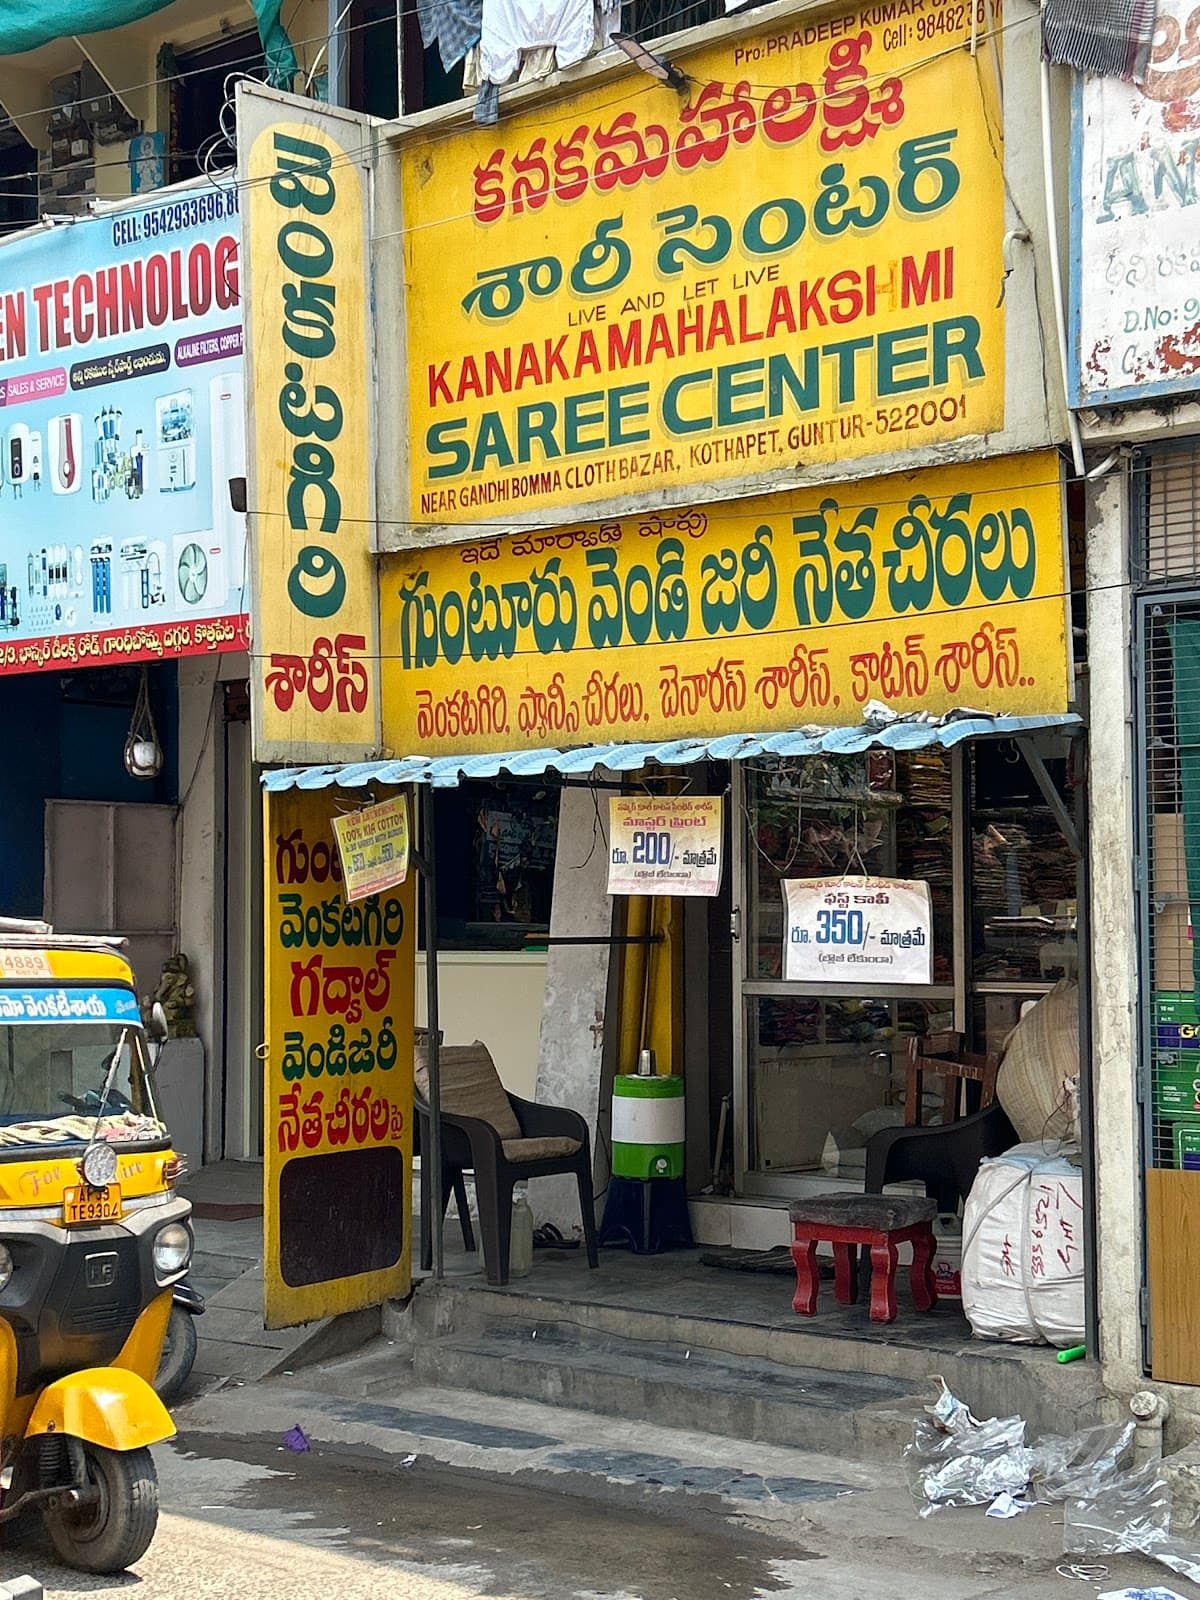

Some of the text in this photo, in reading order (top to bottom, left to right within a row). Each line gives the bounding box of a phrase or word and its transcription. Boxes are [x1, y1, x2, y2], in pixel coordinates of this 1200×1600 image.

[860, 0, 924, 29] KUMAR
[113, 217, 141, 247] CELL:
[461, 129, 960, 319] శారీ సెంటర్
[568, 264, 780, 327] LIVE AND LET LIVE
[7, 381, 29, 397] SALES
[36, 374, 65, 392] SERVICE
[427, 315, 986, 480] SAREE CENTER
[421, 490, 456, 514] NEAR
[689, 430, 783, 467] KOTHAPET,
[399, 492, 1036, 669] గుంటూరు వెండి జరీ నేత చీరలు
[265, 634, 368, 713] శారీస్
[660, 655, 746, 718] బెనారస్
[754, 643, 840, 709] శారీస్,
[850, 633, 929, 701] కాటన్
[377, 812, 405, 832] COTTON
[5, 956, 44, 969] 4889
[880, 927, 925, 949] మాత్రమే
[290, 949, 396, 1025] గద్వాల్
